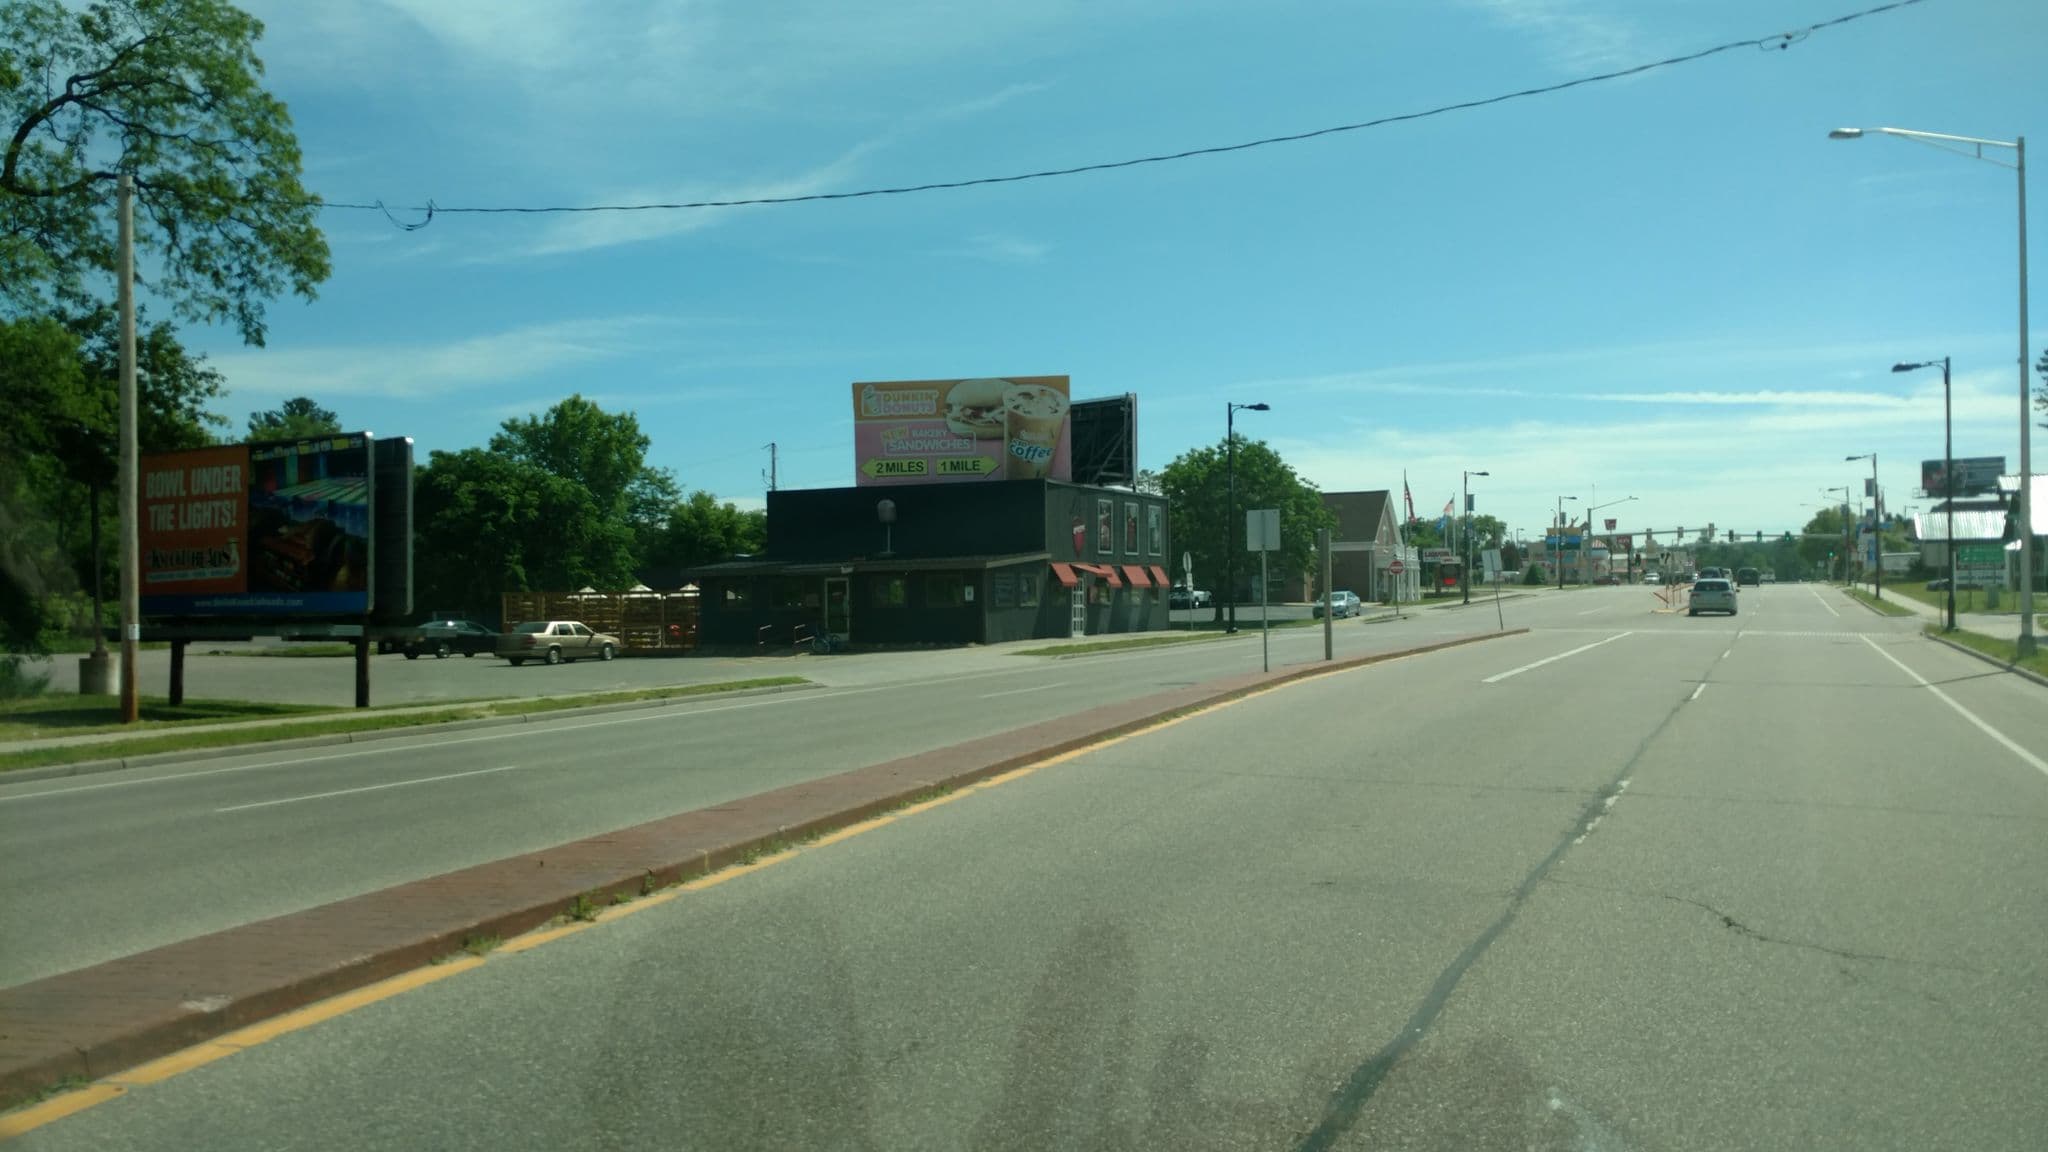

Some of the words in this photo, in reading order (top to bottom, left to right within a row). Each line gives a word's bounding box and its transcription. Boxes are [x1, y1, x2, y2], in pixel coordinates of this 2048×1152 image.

[889, 438, 970, 451] SANDWICHES
[876, 462, 884, 474] 2
[886, 460, 925, 473] MILES
[940, 461, 946, 472] 1
[950, 459, 981, 472] MILE
[145, 469, 187, 499] BOWL
[191, 464, 242, 495] UNDER
[148, 503, 176, 532] THE
[178, 498, 238, 531] LIGHTS!
